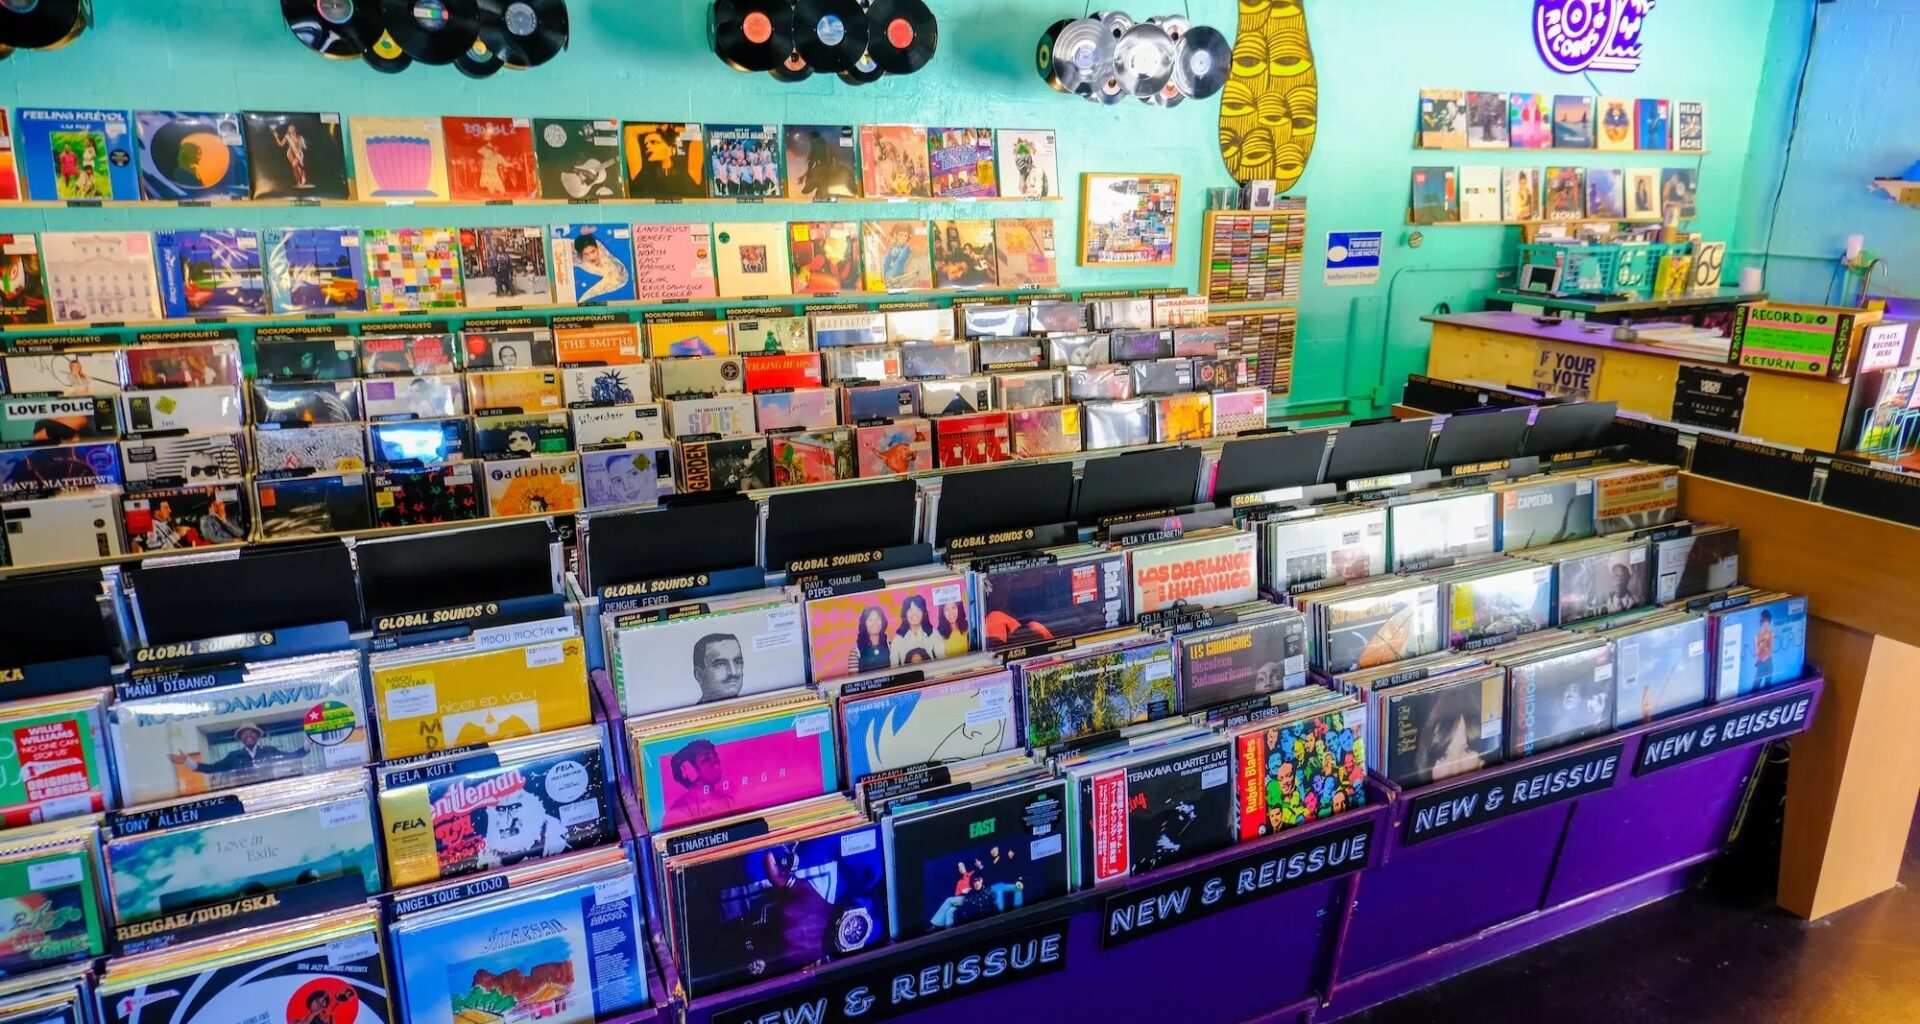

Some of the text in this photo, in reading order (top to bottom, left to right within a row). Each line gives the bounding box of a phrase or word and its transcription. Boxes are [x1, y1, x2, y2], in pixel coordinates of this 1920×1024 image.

[23, 111, 74, 120] FEELING
[1680, 103, 1701, 113] HEAD
[1680, 139, 1702, 149] ACHE
[1752, 308, 1803, 324] RECORD
[1731, 307, 1746, 360] RECORD
[1878, 332, 1898, 341] PLACE
[561, 337, 634, 350] THE SMITHS
[1832, 318, 1849, 371] RETURN
[1872, 340, 1900, 350] RECORDS
[1556, 352, 1596, 375] YOUR
[1743, 354, 1796, 370] RETURN
[1553, 368, 1591, 390] VOTE
[8, 404, 48, 417] LOVE
[1733, 439, 1777, 457] ARRIVALS
[1791, 452, 1815, 464] NEW
[1455, 463, 1477, 476] GLOBAL
[1831, 461, 1870, 476] RECENT
[3, 474, 115, 492] DAVE MATTHEWS
[129, 489, 177, 500] JONATHAN
[1234, 493, 1263, 505] GLOBAL
[951, 530, 1023, 549] GLOBAL SOUNDS
[1122, 537, 1138, 546] ELIA
[1148, 528, 1183, 541] ELIZABETH
[791, 551, 871, 572] GLOBAL SOUNDS
[1137, 564, 1170, 587] LOS
[604, 575, 695, 599] GLOBAL SOUNDS
[807, 587, 834, 599] PIPER
[604, 595, 670, 613] DENGUE FEVER
[378, 604, 483, 631] GLOBAL SOUNDS
[1176, 617, 1213, 633] MANU CHAO
[480, 626, 556, 645] MDOU MOCTAR
[137, 645, 195, 663] GLOBAL
[1007, 647, 1027, 660] ASIA
[1190, 643, 1204, 660] LES
[125, 674, 216, 699] MANU DIBANGO
[385, 674, 413, 684] MDOU
[391, 678, 427, 689] MOCTAR
[1390, 670, 1421, 685] GILBERTO
[28, 723, 64, 737] WILLIE
[1227, 714, 1249, 728] BOMBA
[21, 729, 75, 746] WILLIAMS
[1644, 699, 1809, 766] NEW & REISSUE
[21, 738, 80, 755] NO ONE CAN
[33, 748, 68, 761] STOP US
[391, 761, 456, 784] FELA KUTI
[554, 762, 574, 773] FELA
[1128, 749, 1228, 784] TERAKAWA QUARTET LIVE
[27, 771, 87, 791] ORIGINAL
[1243, 738, 1258, 815] Rubén Blades
[30, 780, 90, 801] CLASSICS
[1414, 755, 1618, 834] NEW & REISSUE
[118, 818, 150, 835] TONY
[158, 810, 199, 828] ALLEN
[391, 817, 427, 834] FELA
[969, 817, 996, 839] EAST
[216, 833, 263, 854] Love in
[673, 831, 730, 854] TINARIWEN
[246, 846, 279, 863] Exile
[1110, 834, 1368, 937] NEW & REISSUE
[395, 876, 503, 915] ANGELIQUE KIDJO
[116, 893, 281, 942] REGGAE/DUB/SKA
[310, 963, 323, 971] JAZZ
[323, 964, 345, 972] RECORDS
[344, 965, 369, 973] PRESENTS
[843, 933, 1062, 1018] & REISSUE
